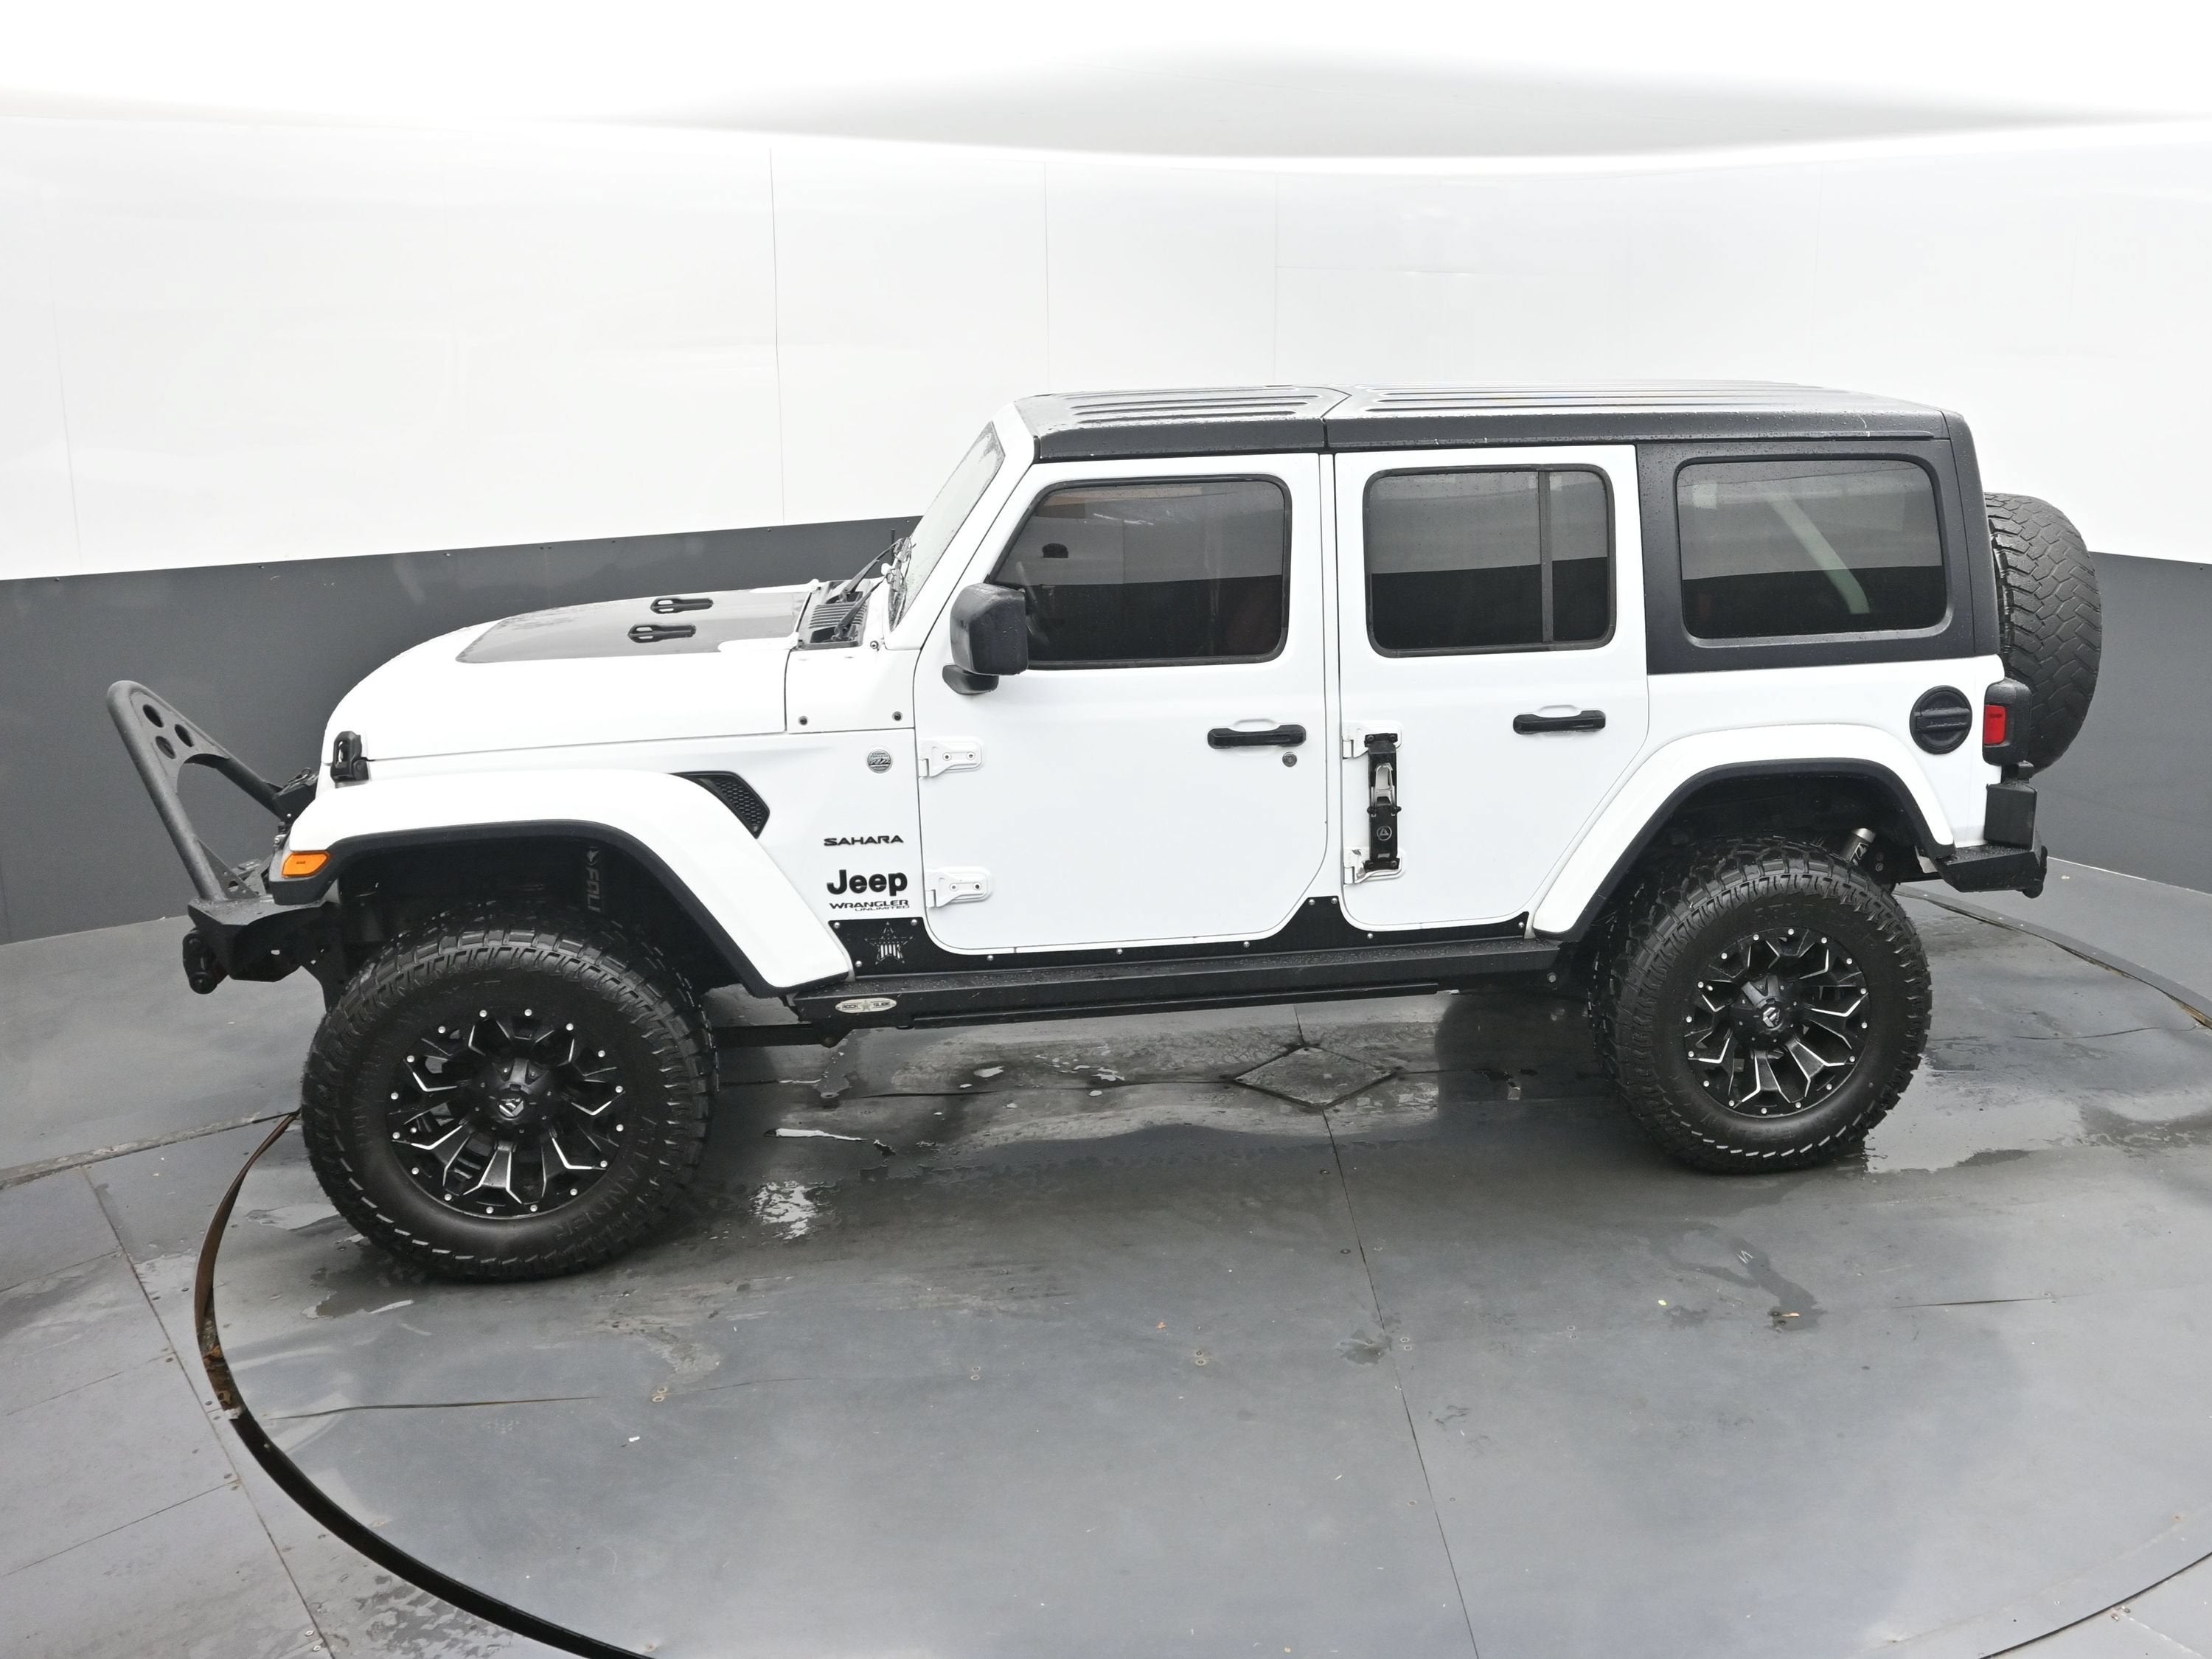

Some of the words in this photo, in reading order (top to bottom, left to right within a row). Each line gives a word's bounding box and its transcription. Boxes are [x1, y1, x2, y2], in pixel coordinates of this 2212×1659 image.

[824, 835, 904, 846] SAHARA
[827, 869, 908, 897] Jeep
[830, 900, 908, 910] WRANGLER
